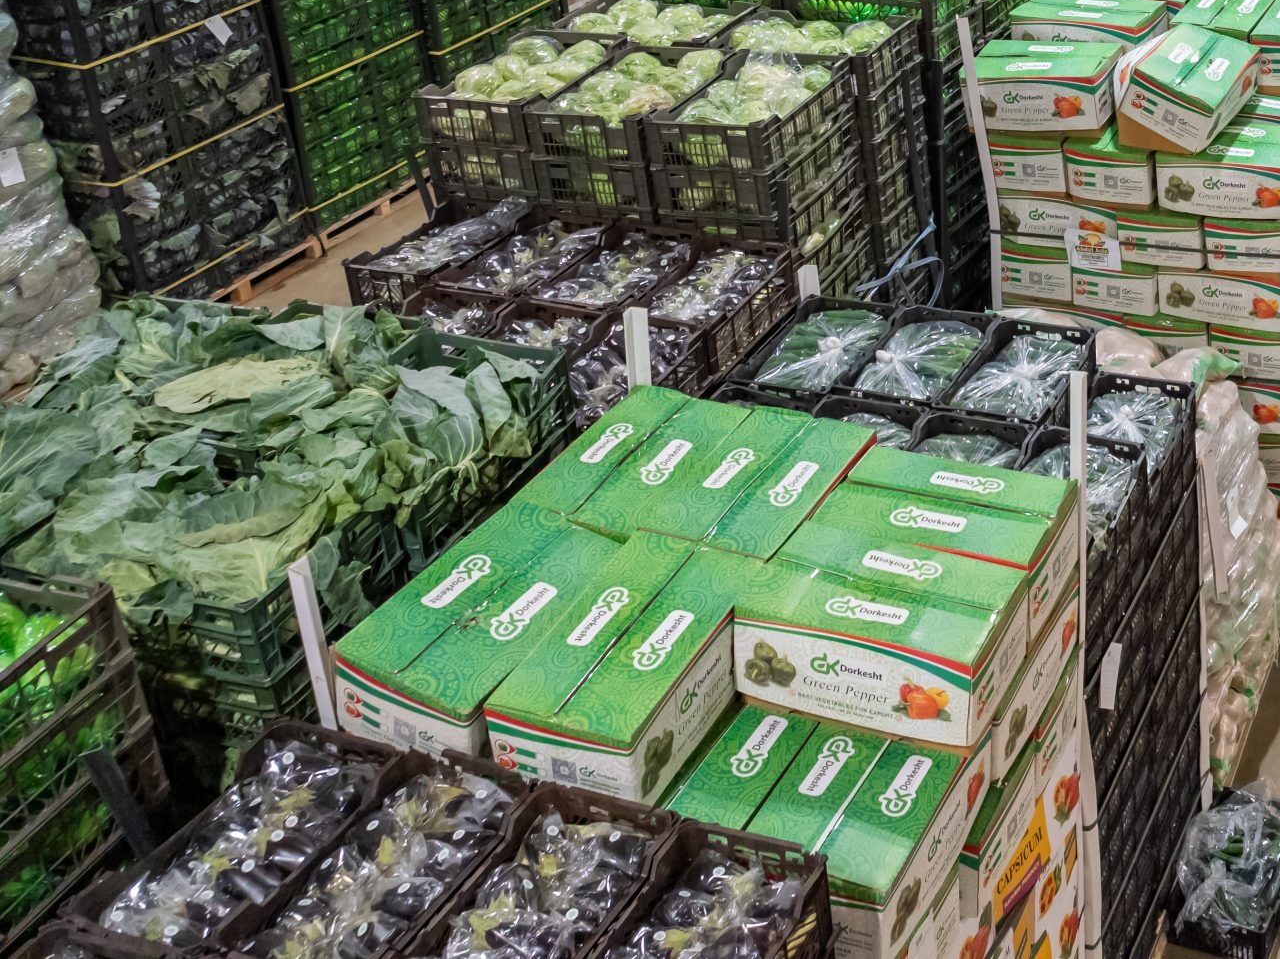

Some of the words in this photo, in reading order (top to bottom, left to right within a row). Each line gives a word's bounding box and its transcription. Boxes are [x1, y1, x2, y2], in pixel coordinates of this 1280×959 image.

[1198, 191, 1222, 201] Green
[1223, 194, 1250, 204] Pepper
[1220, 181, 1246, 189] Dorkesht
[1199, 299, 1220, 309] Green
[1221, 301, 1247, 311] Pepper
[1218, 290, 1243, 298] Dorkesht
[659, 442, 685, 468] Dorkesht
[920, 515, 961, 529] Dorkesht
[428, 576, 465, 605] Dorkesht
[515, 585, 551, 618] Dorkesht
[575, 609, 607, 643] Dorkesht
[859, 606, 903, 621] Dorkesht
[655, 613, 687, 646] Dorkesht
[840, 664, 883, 681] Dorkesht
[803, 675, 840, 692] Green
[845, 684, 889, 704] Pepper
[814, 696, 854, 710] VEGETABLES
[753, 718, 781, 751] Dorkesht
[807, 760, 834, 793] Dorkesht
[899, 758, 925, 792] Dorkesht
[996, 826, 1043, 895] CAPSICUM
